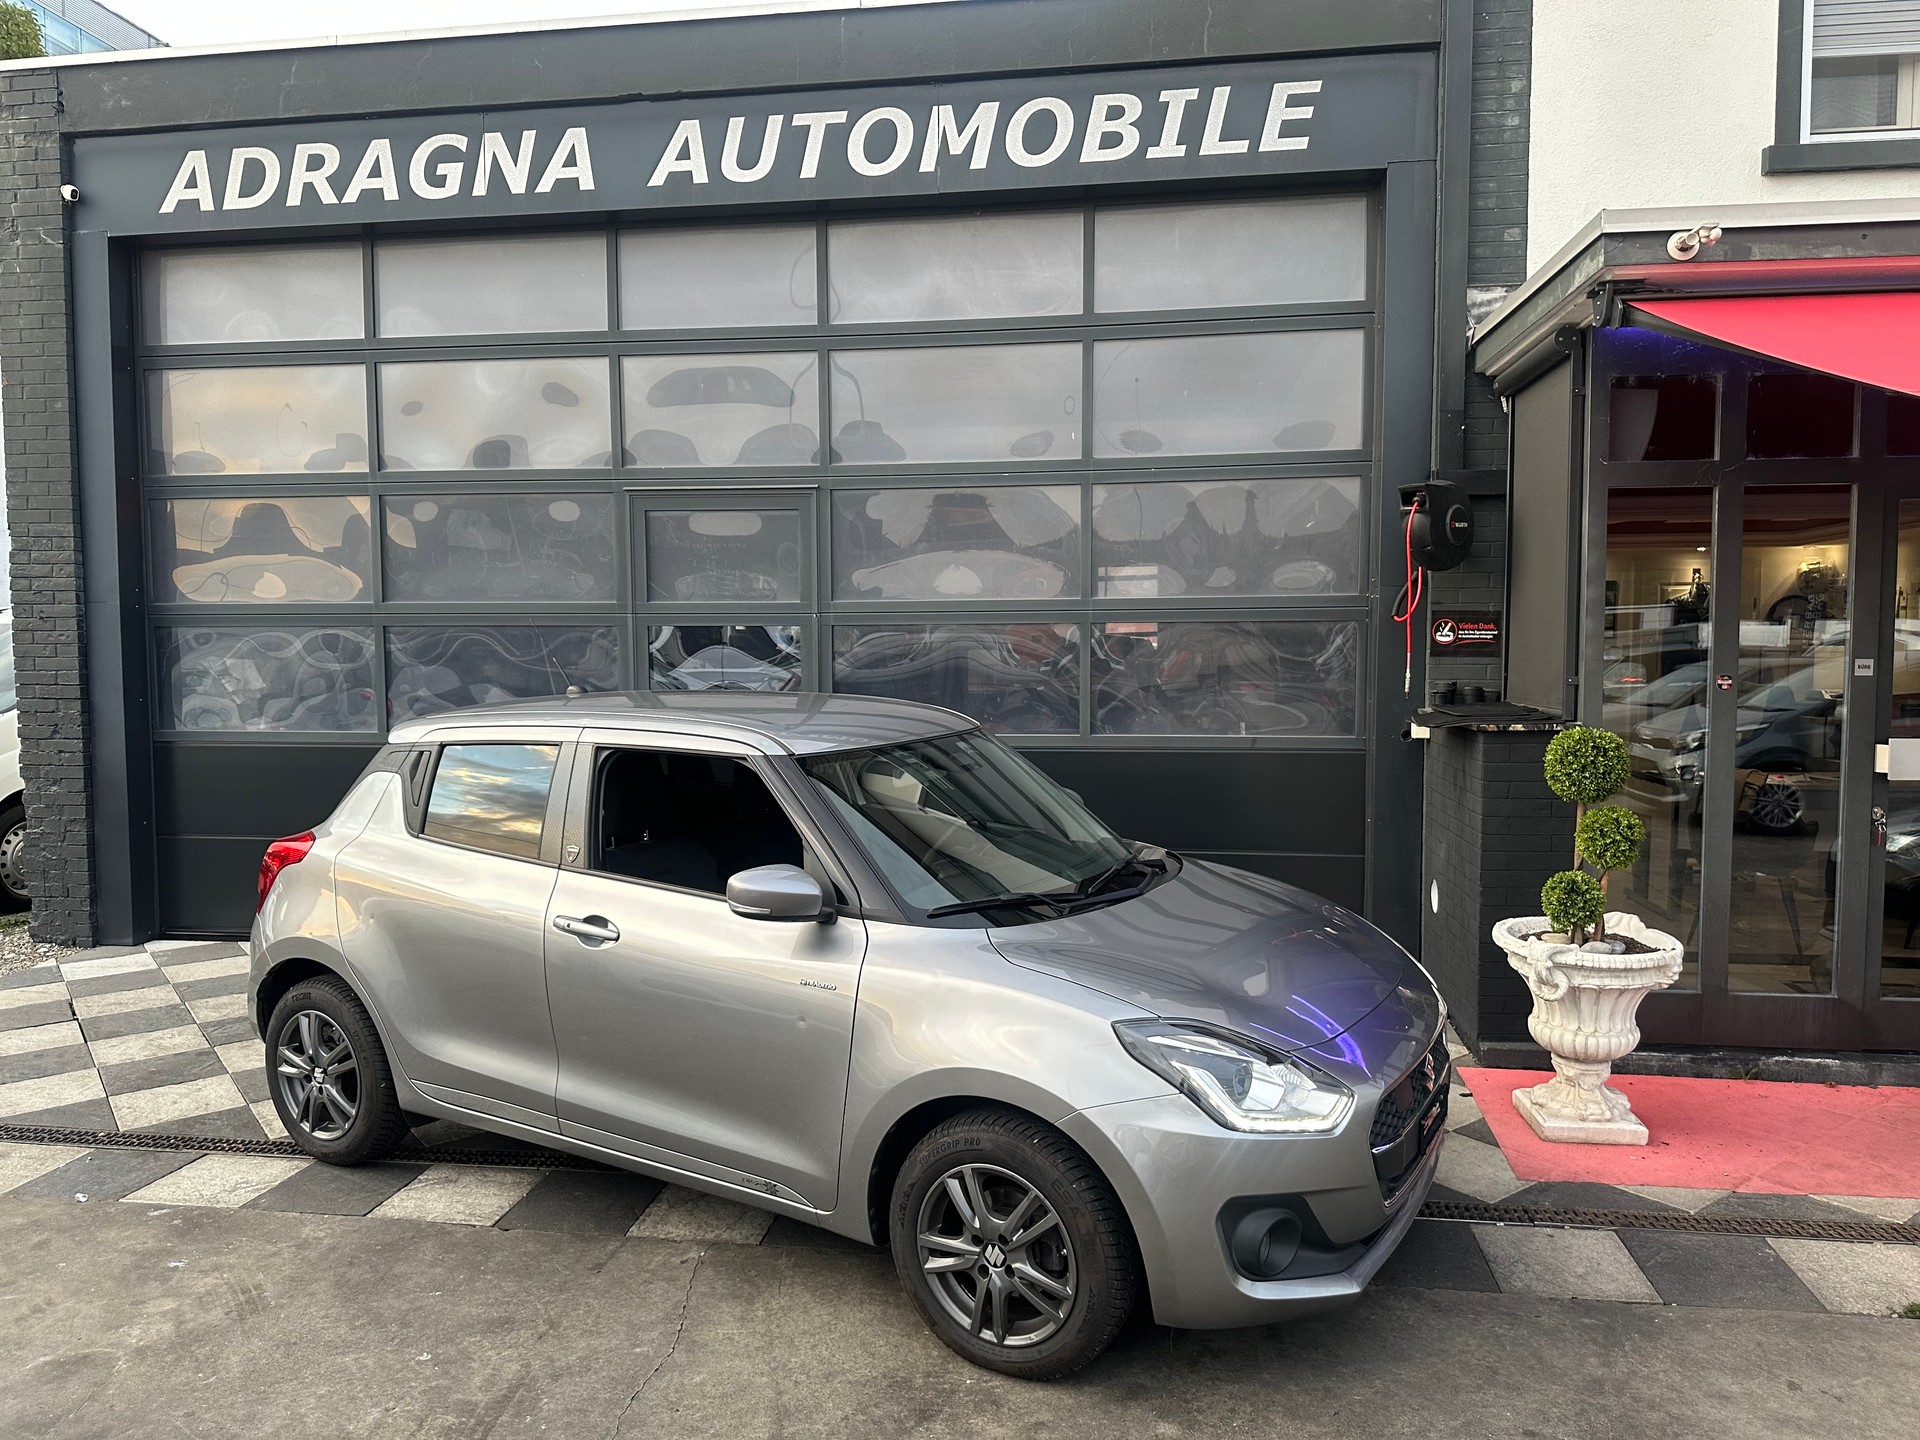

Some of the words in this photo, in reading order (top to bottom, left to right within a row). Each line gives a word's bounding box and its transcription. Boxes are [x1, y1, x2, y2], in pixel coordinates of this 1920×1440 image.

[158, 127, 595, 214] ADRAGNA
[646, 79, 1323, 187] AUTOMOBILE
[919, 1139, 960, 1167] SUPERGRIP
[963, 1137, 981, 1147] PRO
